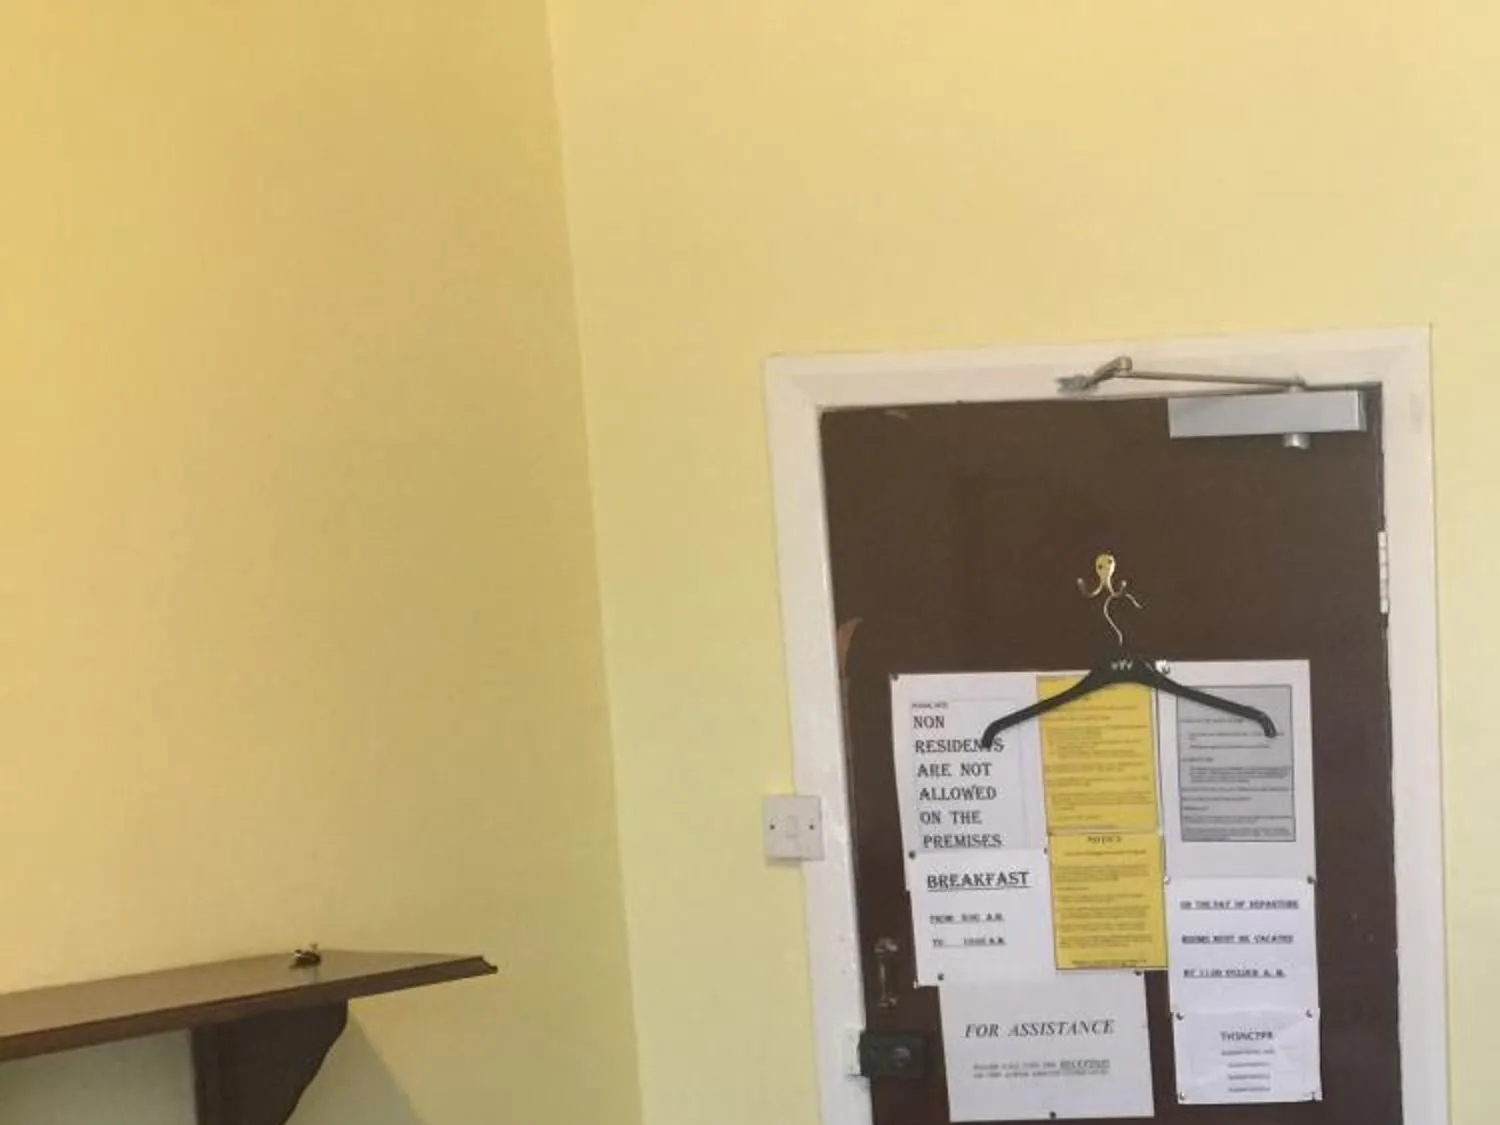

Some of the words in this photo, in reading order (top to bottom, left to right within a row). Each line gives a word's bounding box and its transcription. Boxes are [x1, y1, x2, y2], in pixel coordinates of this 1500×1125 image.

[913, 715, 945, 729] NON
[918, 763, 952, 777] ARE
[960, 762, 992, 777] NOT
[920, 785, 997, 801] ALLOWED
[920, 811, 941, 825] ON
[949, 810, 982, 824] THE
[923, 833, 1002, 848] PREMISES
[927, 871, 1030, 889] BREAKFAST
[963, 1023, 1000, 1039] FOR
[1008, 1019, 1115, 1038] ASSISTANCE
